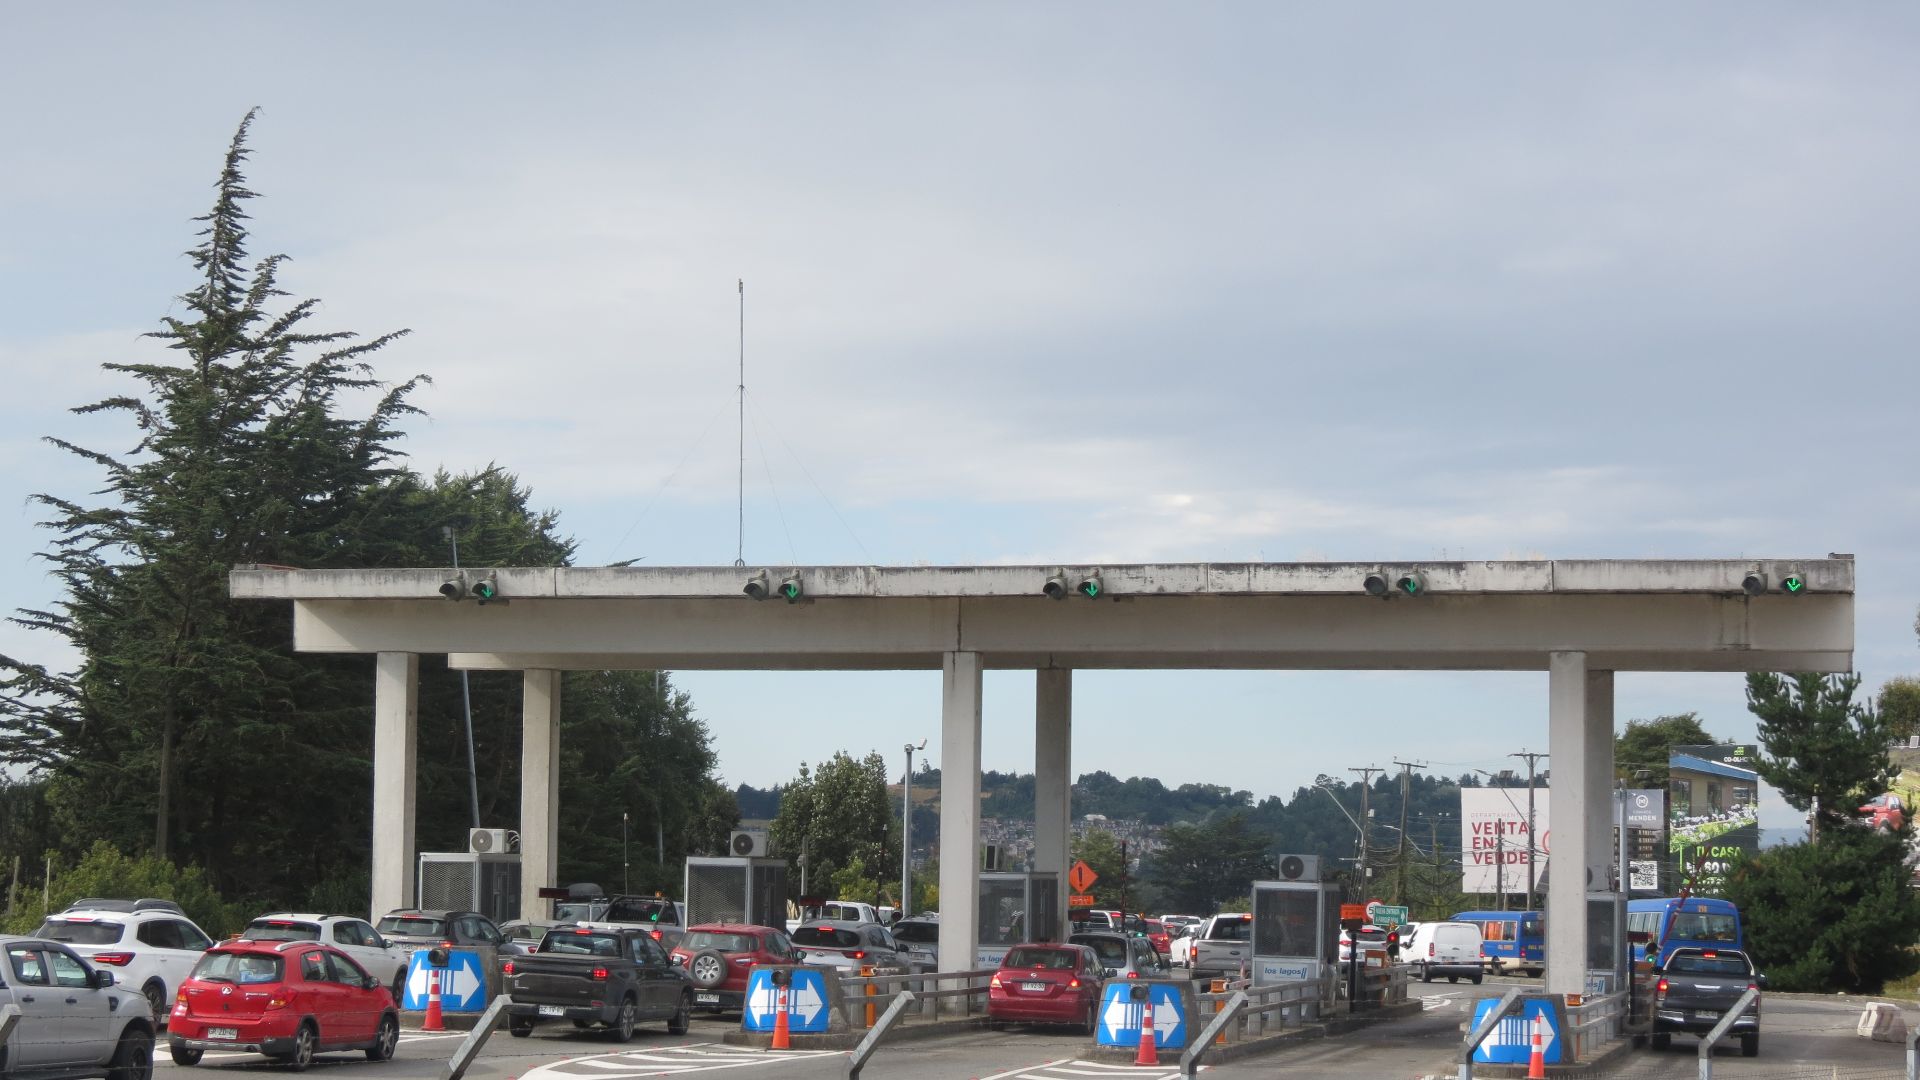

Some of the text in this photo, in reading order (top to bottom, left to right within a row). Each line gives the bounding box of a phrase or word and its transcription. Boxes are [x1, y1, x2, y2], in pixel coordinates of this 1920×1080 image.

[1472, 822, 1528, 835] VENTA
[1473, 837, 1494, 849] EN
[1473, 852, 1529, 865] VERDE
[1279, 967, 1301, 975] lagos
